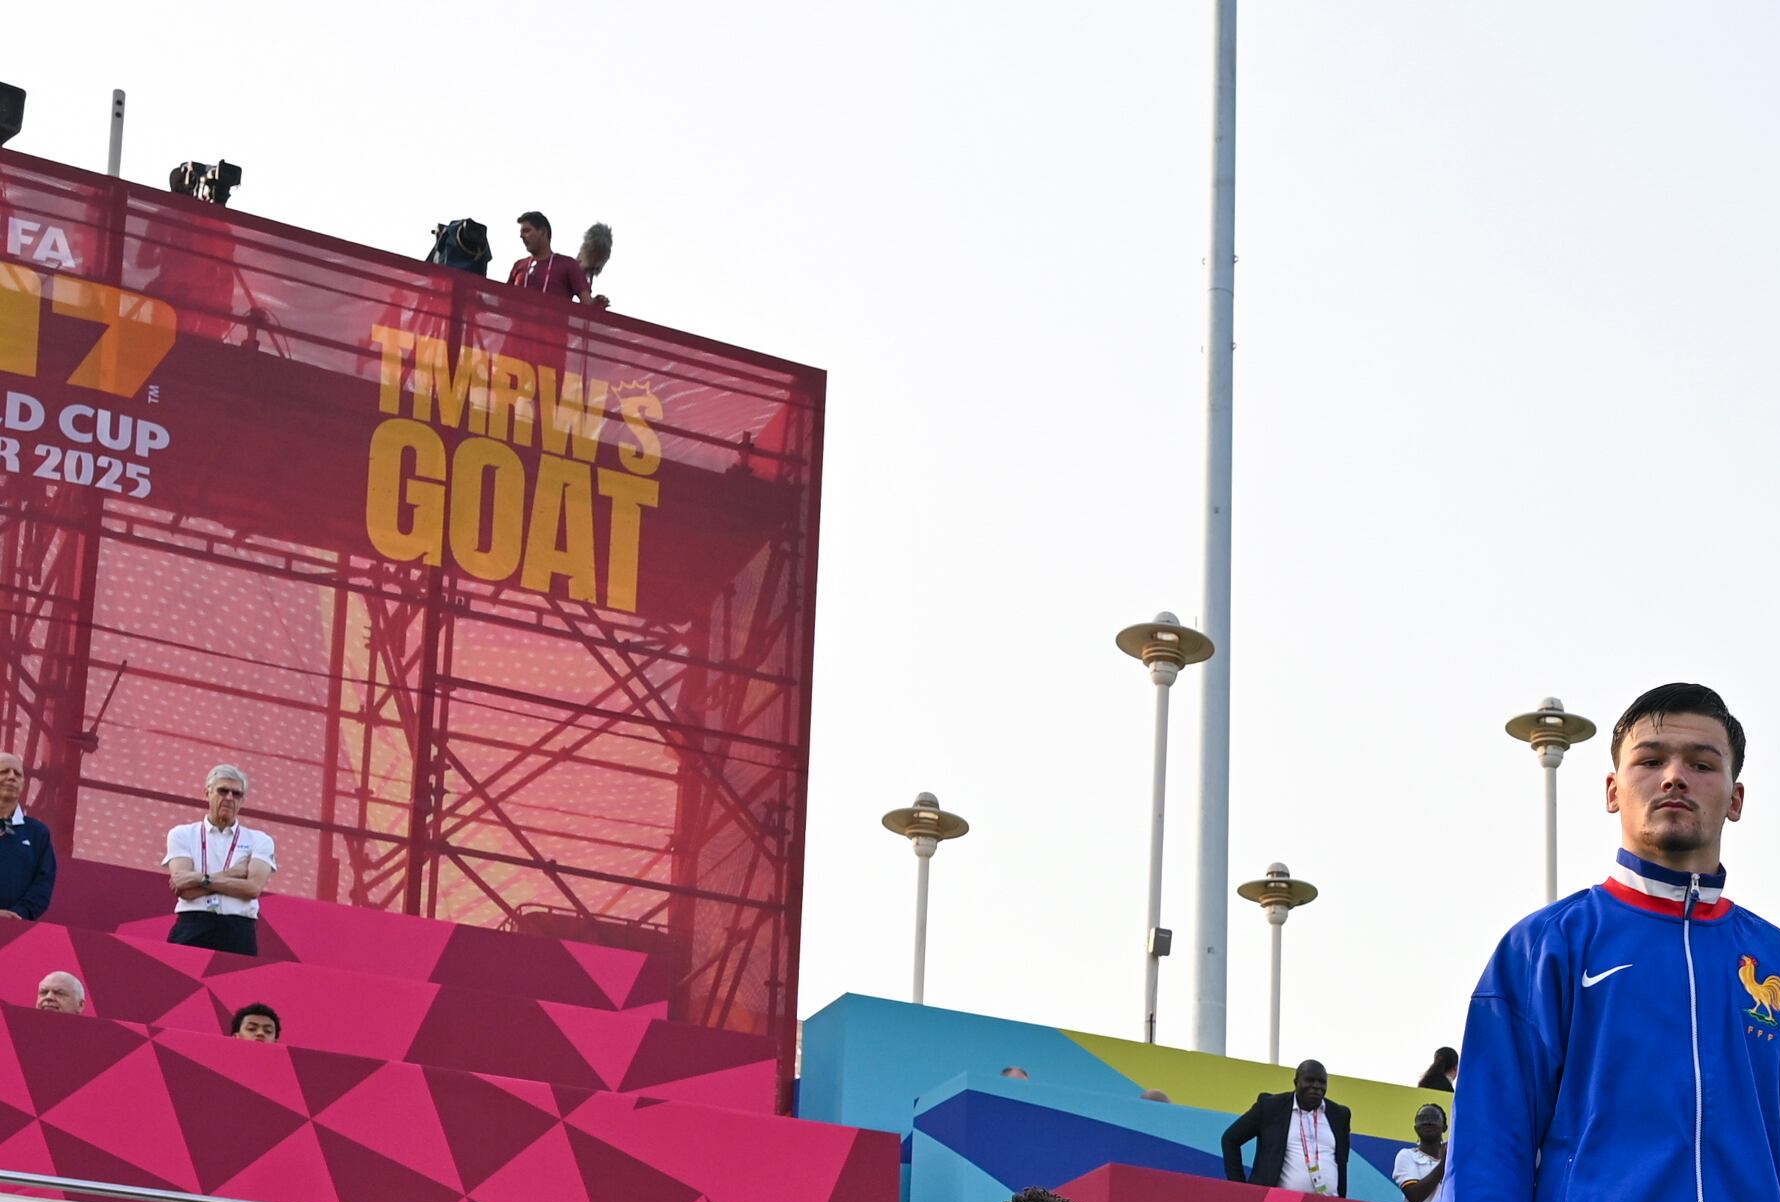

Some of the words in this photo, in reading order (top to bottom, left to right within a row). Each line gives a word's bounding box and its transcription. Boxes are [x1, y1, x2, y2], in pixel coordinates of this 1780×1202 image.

[58, 404, 170, 458] CUP
[33, 444, 152, 499] 2025
[366, 418, 660, 613] GOAT
